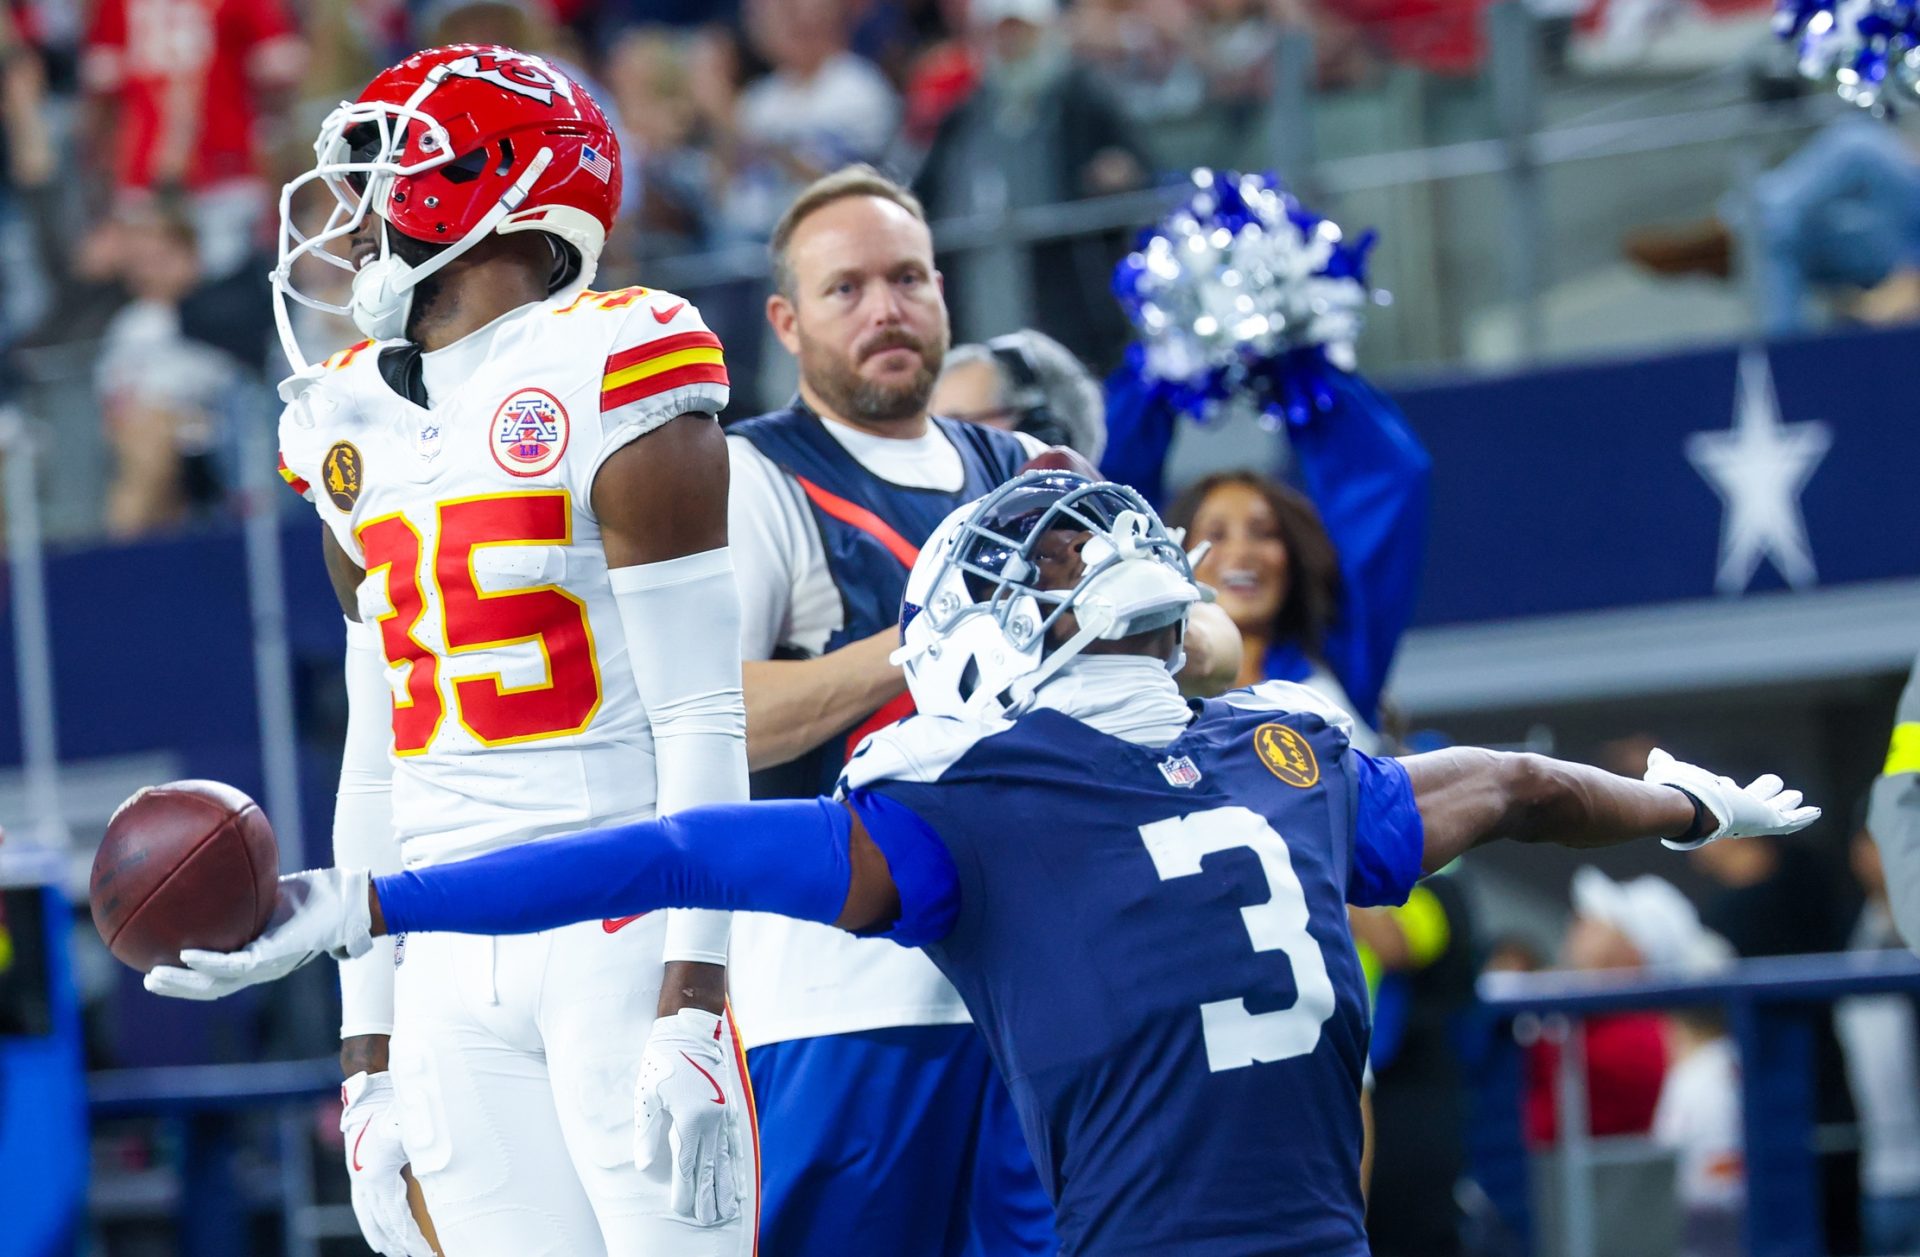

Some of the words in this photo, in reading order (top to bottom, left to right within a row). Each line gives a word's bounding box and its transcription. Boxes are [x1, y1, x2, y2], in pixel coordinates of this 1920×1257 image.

[501, 400, 558, 443] A
[353, 489, 604, 758] 35
[1138, 806, 1336, 1072] 3
